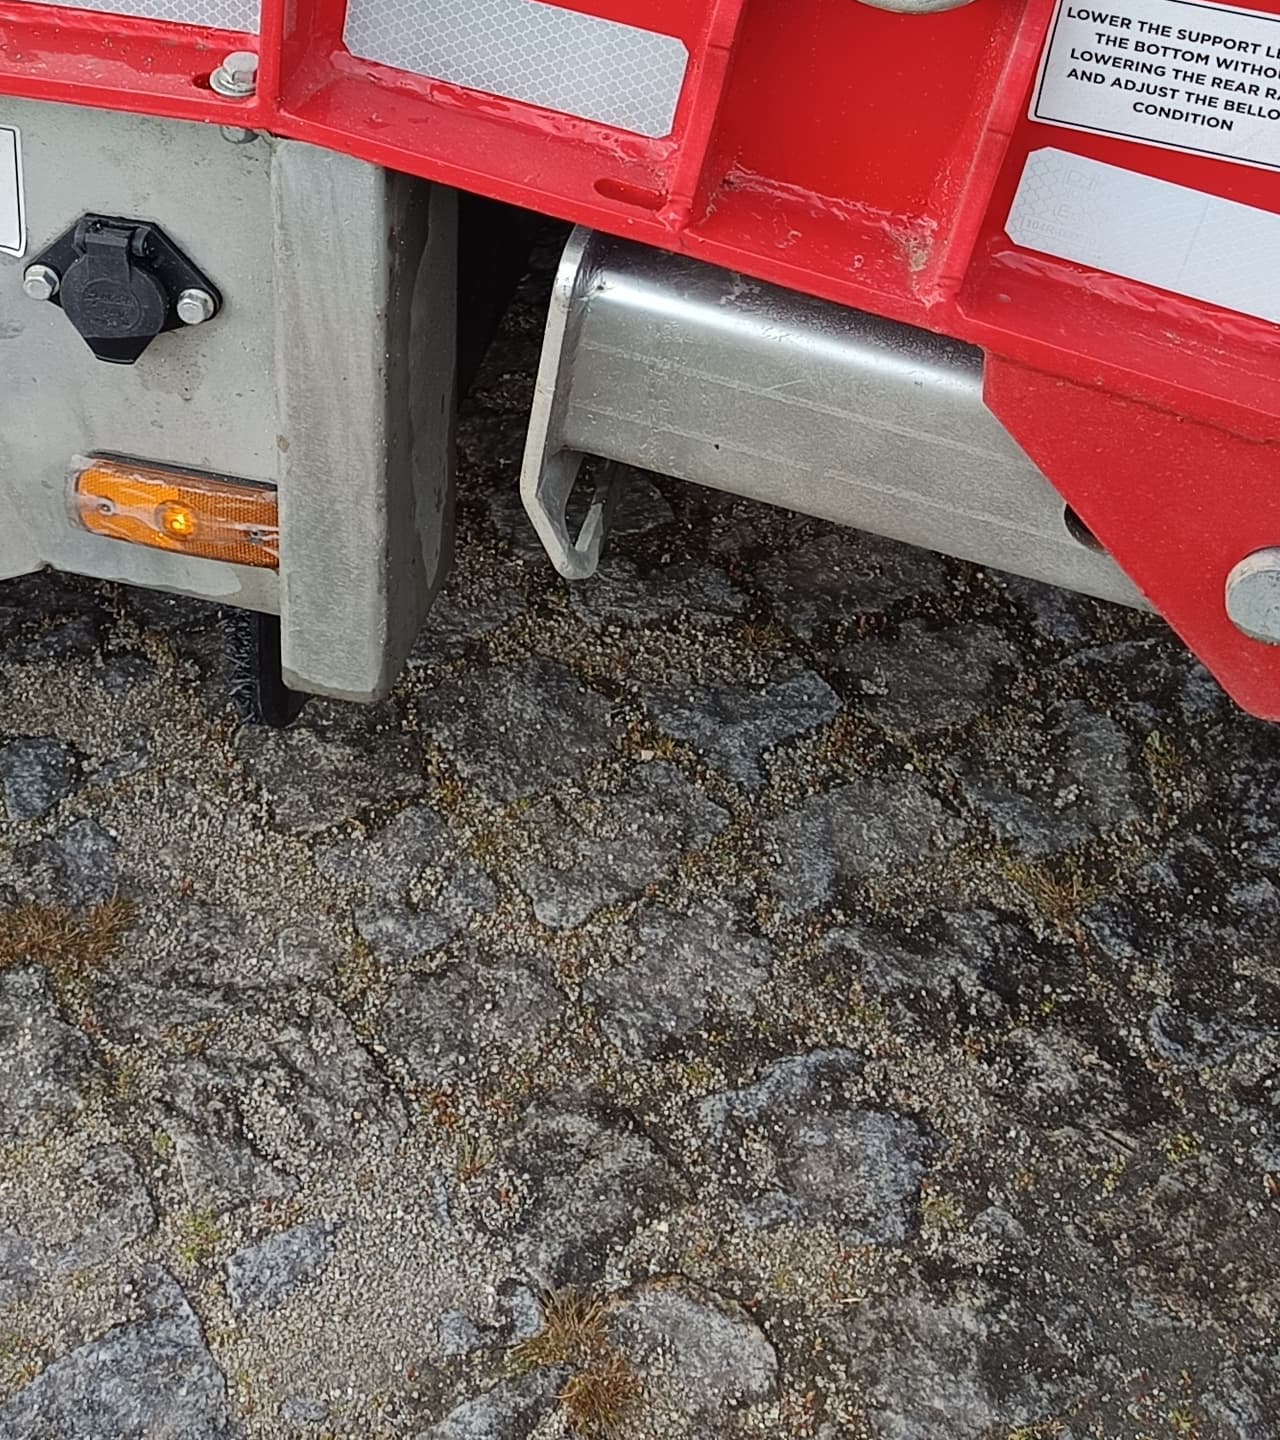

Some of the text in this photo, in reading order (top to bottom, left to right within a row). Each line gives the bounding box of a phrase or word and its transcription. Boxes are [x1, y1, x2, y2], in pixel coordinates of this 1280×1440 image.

[1067, 7, 1132, 30] LOWER
[1137, 20, 1173, 38] THE
[1176, 28, 1262, 55] SUPPORT
[1095, 32, 1130, 50] THE
[1133, 40, 1210, 66] BOTTOM
[1067, 68, 1106, 85] AND
[1110, 77, 1180, 100] ADJUST
[1184, 91, 1220, 108] THE
[1070, 48, 1166, 77] LOWERING
[1172, 68, 1207, 86] THE
[1211, 76, 1260, 97] REAR
[1132, 101, 1234, 131] CONDITION
